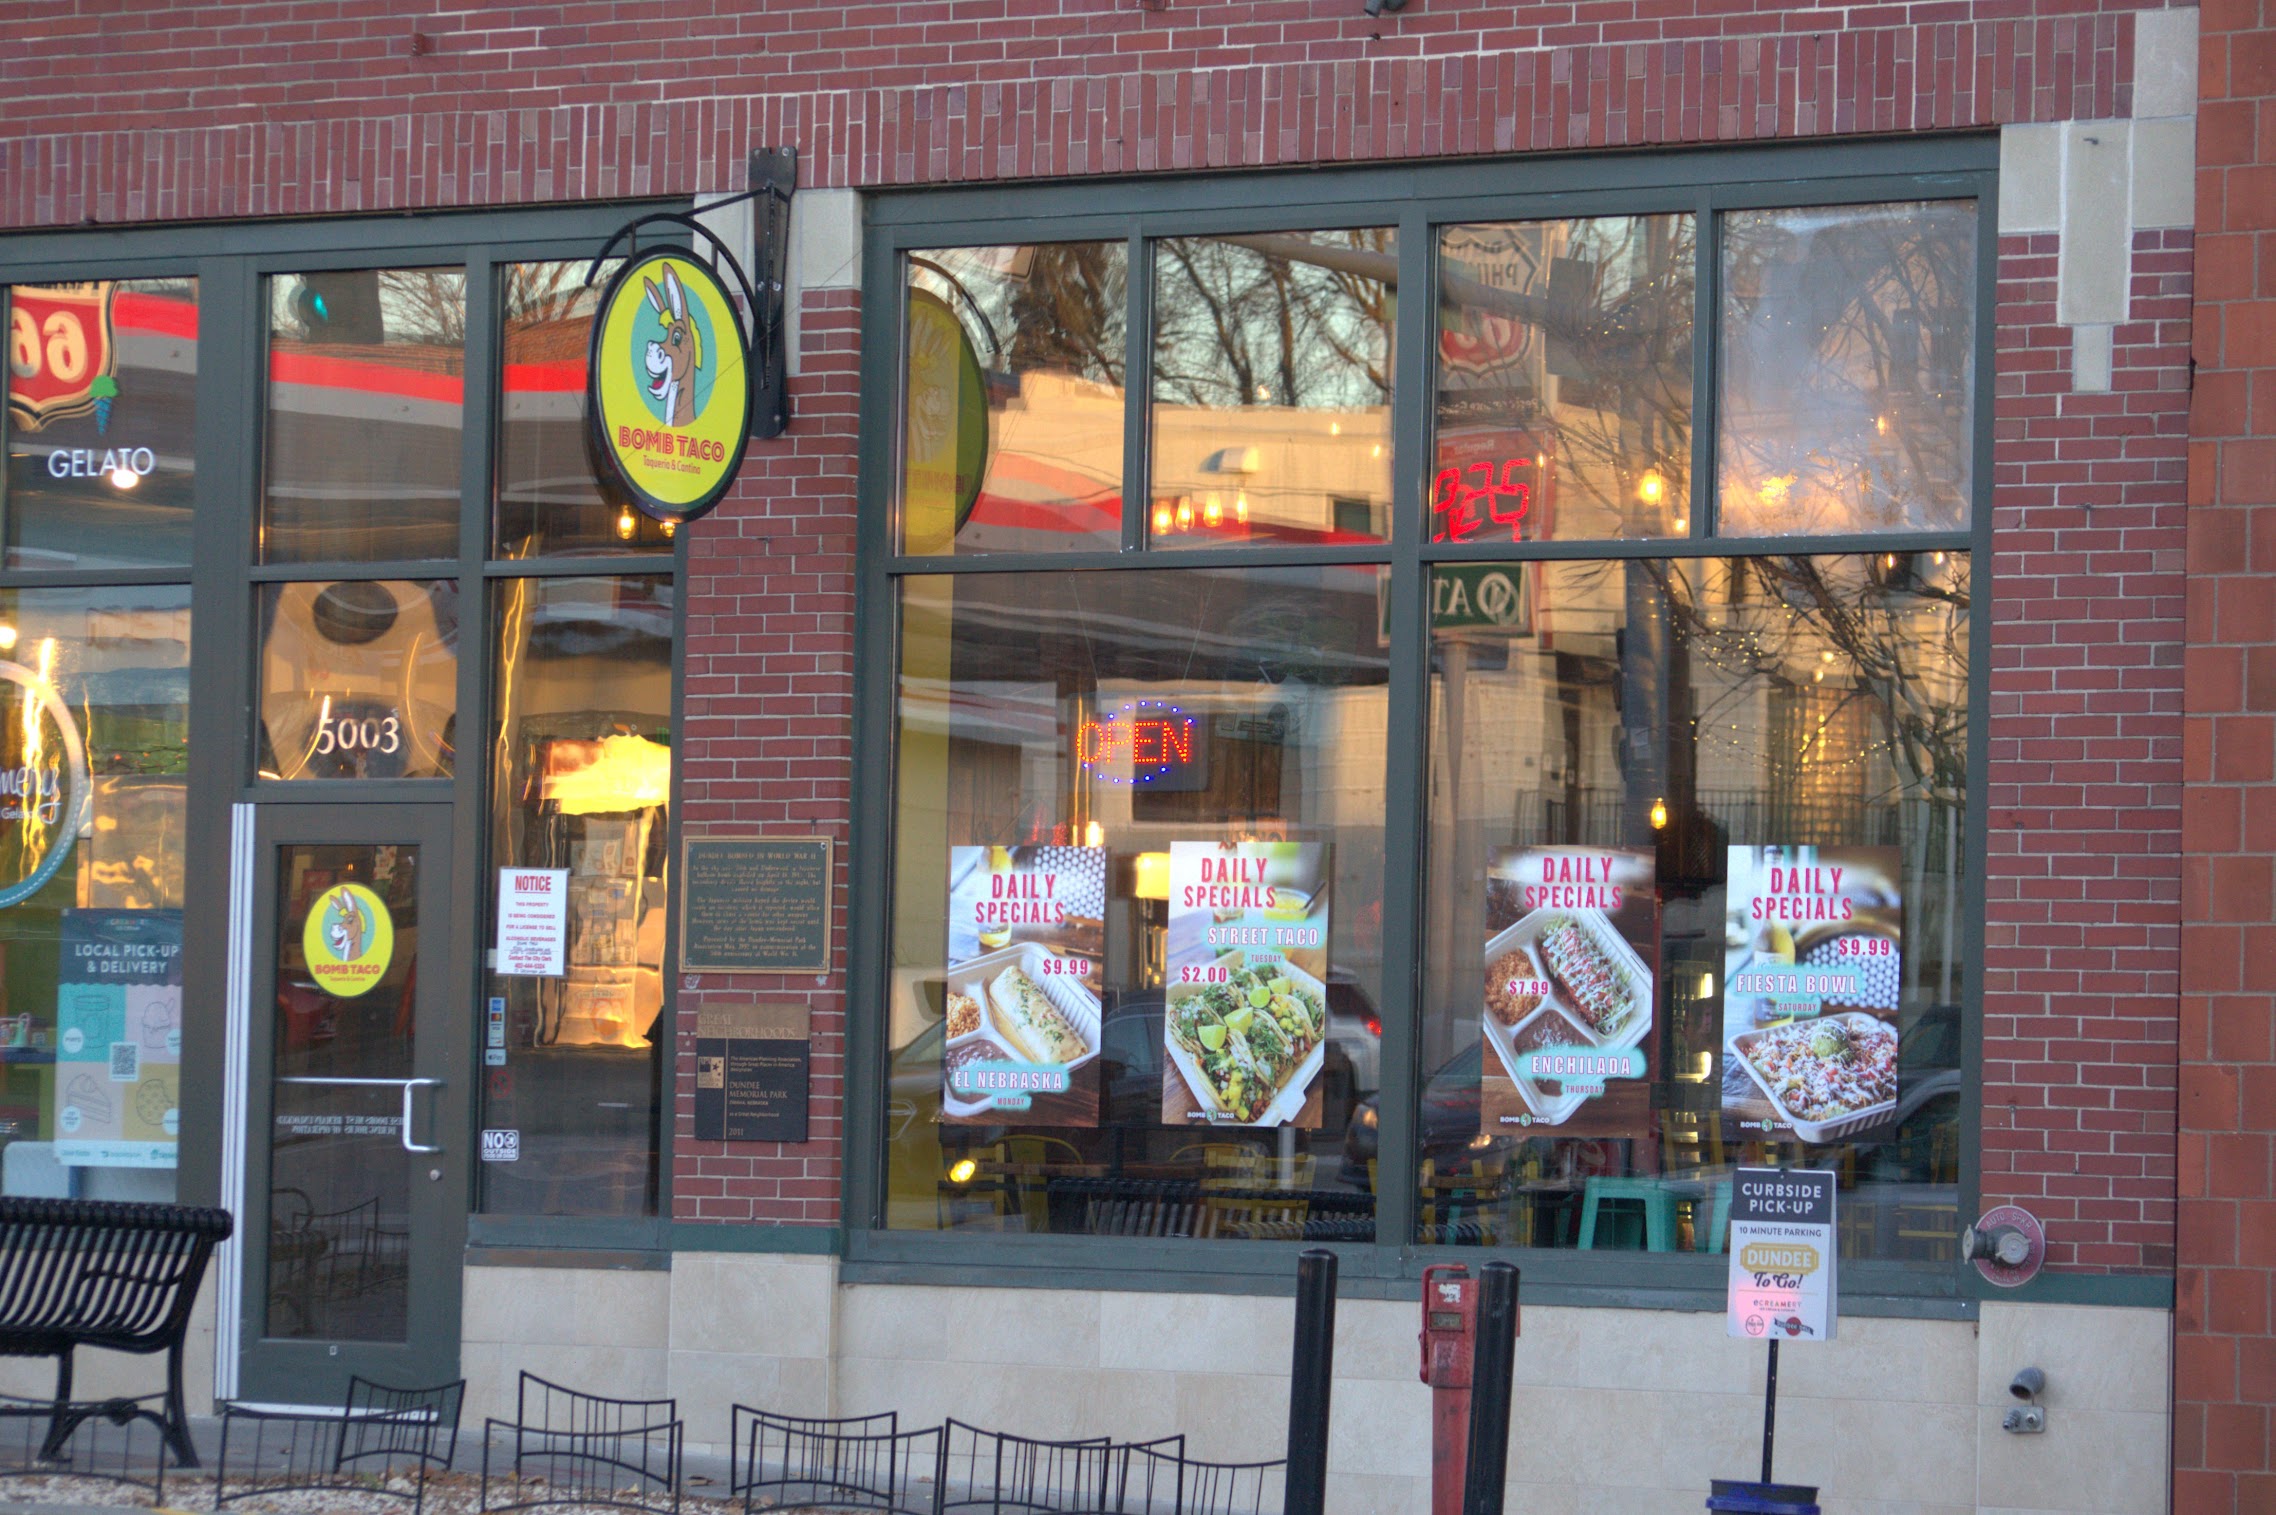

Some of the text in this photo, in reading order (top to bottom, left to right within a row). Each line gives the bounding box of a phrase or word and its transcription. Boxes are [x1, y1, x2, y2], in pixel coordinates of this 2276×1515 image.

[618, 425, 725, 463] BOMB TACO
[48, 447, 155, 479] GELATO
[643, 454, 670, 472] Taqueria
[677, 460, 701, 475] Cantina
[316, 717, 400, 755] 5003
[1076, 720, 1193, 764] OPEN
[1201, 857, 1267, 883] DAILY
[1543, 857, 1614, 884] DAILY
[515, 875, 552, 891] NOTICE
[991, 874, 1057, 899] DAILY
[1770, 867, 1842, 894] DAILY
[1184, 886, 1276, 908] SPECIALS
[1524, 886, 1623, 909] SPECIALS
[975, 902, 1065, 924] SPECIALS
[1751, 897, 1853, 921] SPECIALS
[1207, 927, 1318, 945] STREET TACO
[75, 944, 180, 958] LOCAL PICK-UP
[1838, 938, 1890, 956] $9.99
[1043, 957, 1089, 976] $9.99
[1250, 953, 1282, 963] TUESDAY
[100, 961, 168, 974] DELIVERY
[314, 964, 381, 976] BOMB TACO
[1182, 966, 1227, 984] $2.00
[1509, 980, 1549, 996] $7.99
[1736, 974, 1857, 994] FIESTA BOWL
[1778, 1003, 1817, 1012] SATURDAY
[698, 1014, 733, 1025] GREAT
[697, 1026, 796, 1039] NEIGHBORHOODS
[1531, 1055, 1630, 1075] ENCHILADA
[729, 1081, 761, 1089] DUNDEE
[954, 1070, 1063, 1089] EL NEBRASKA
[729, 1090, 788, 1099] MEMORIAL PARK
[1565, 1084, 1605, 1094] THURSDAY
[996, 1096, 1025, 1107] MONDAY
[1499, 1115, 1550, 1124] BOMB TACO
[1740, 1120, 1793, 1130] BOMB TACO
[484, 1132, 504, 1148] NO
[728, 1128, 744, 1136] 2011
[1741, 1182, 1822, 1198] CURBSIDE
[1749, 1201, 1814, 1215] PICK-UP
[1985, 1212, 2005, 1230] AUTO
[1739, 1226, 1822, 1238] 10 MINUTE PARKING
[1747, 1249, 1812, 1268] DUNDEE
[1754, 1271, 1804, 1289] To Go!
